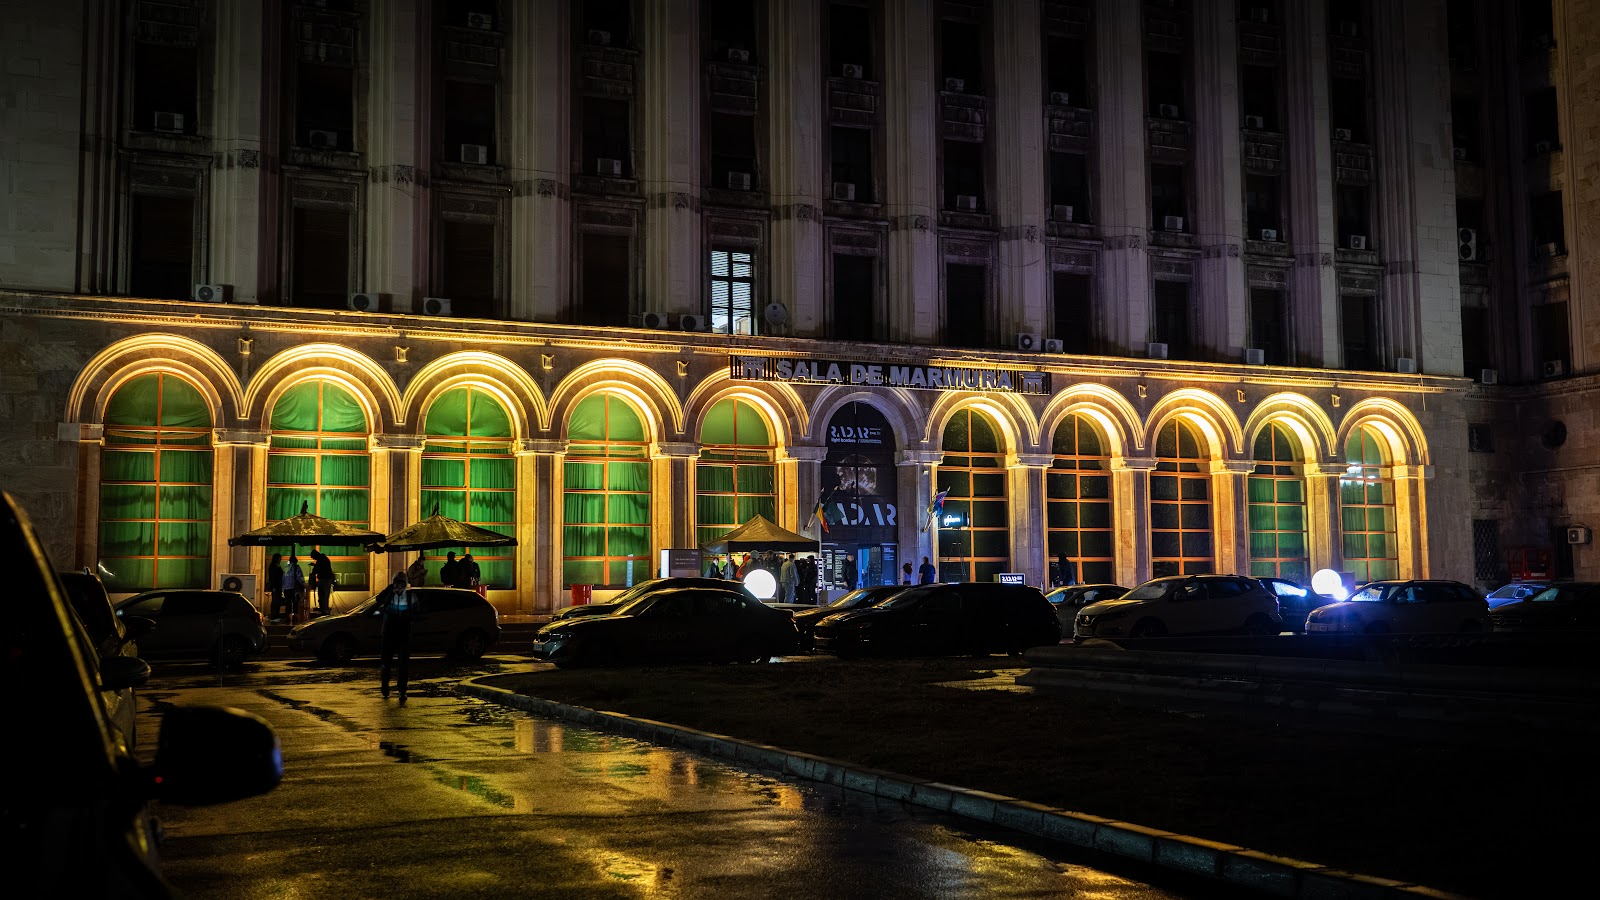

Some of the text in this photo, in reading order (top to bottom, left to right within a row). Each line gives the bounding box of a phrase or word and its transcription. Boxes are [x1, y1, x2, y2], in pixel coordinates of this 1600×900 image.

[776, 359, 1013, 389] SALA DE MARMURA
[830, 425, 869, 438] RADAR
[827, 502, 897, 526] ADAR
